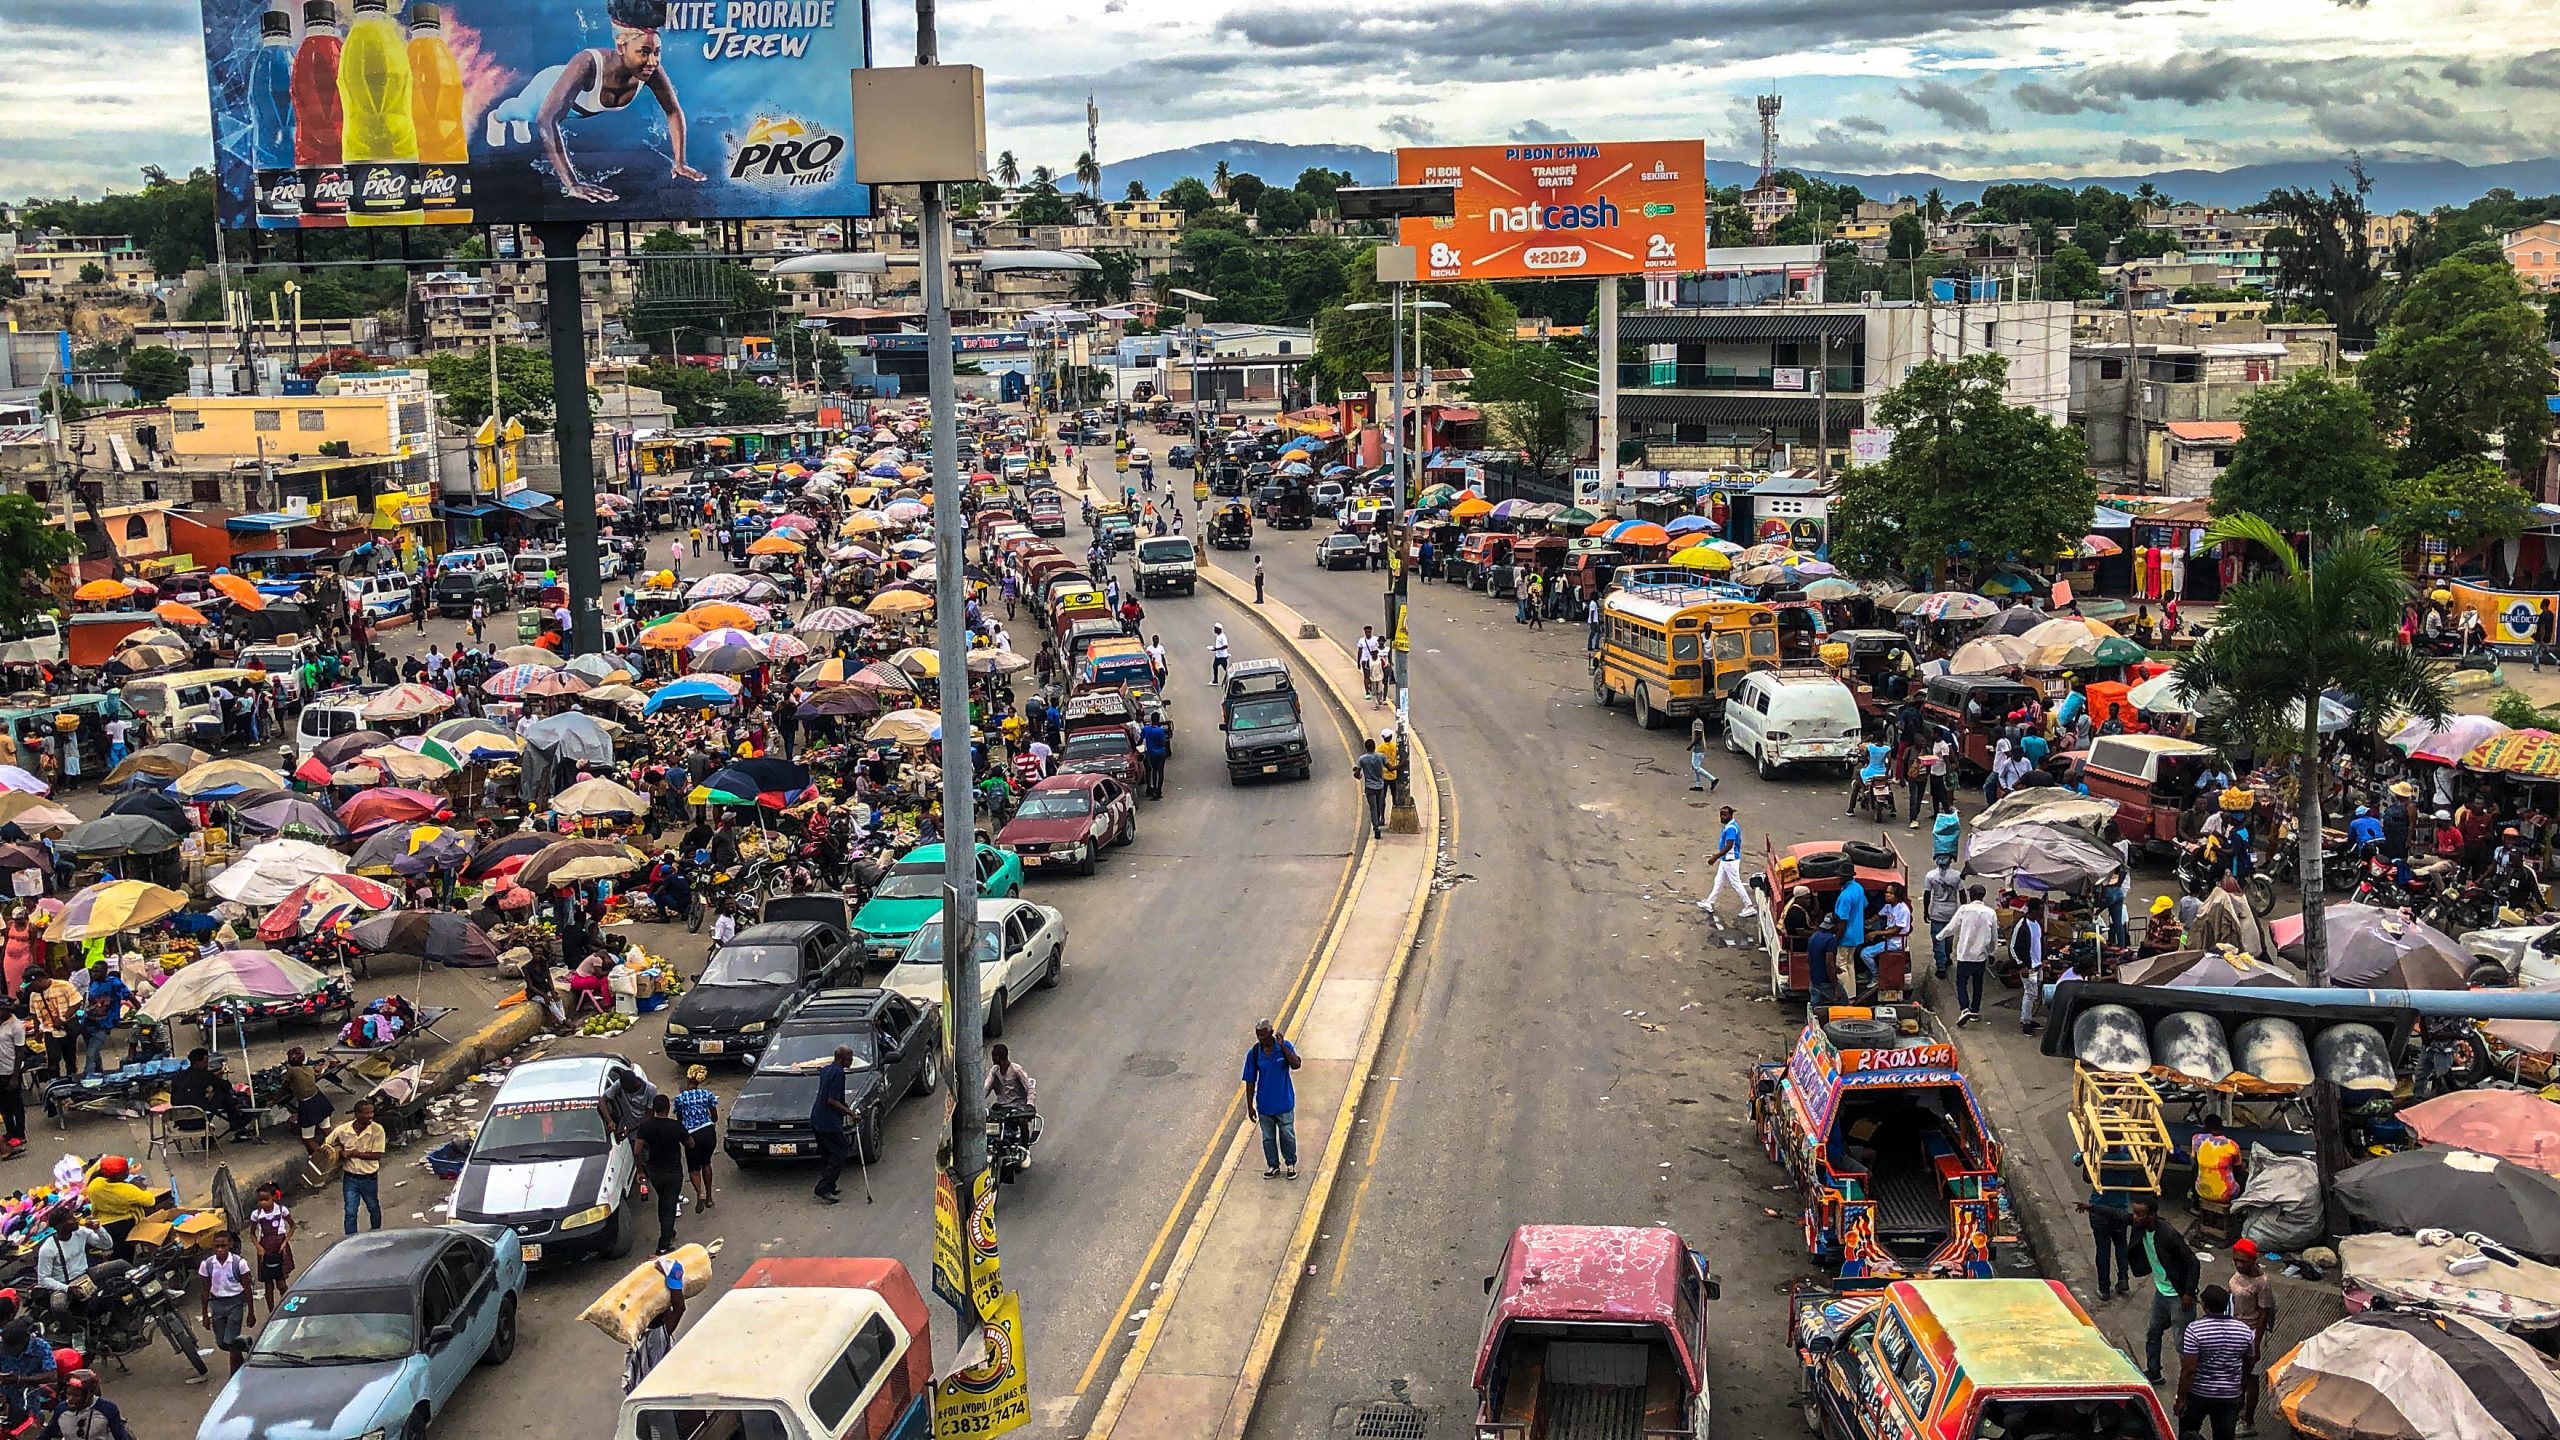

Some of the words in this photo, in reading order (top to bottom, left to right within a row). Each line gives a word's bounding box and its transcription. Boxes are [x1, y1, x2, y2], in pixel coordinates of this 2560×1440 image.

[665, 2, 716, 30] KITE
[727, 1, 835, 28] PRORADE
[703, 27, 810, 60] JEREW
[730, 135, 845, 178] PRO
[1506, 149, 1520, 161] PI
[1524, 148, 1552, 160] BON
[1557, 146, 1599, 159] CHWA
[790, 165, 834, 186] rade
[1425, 167, 1436, 178] PI
[1437, 166, 1461, 177] BON
[1538, 176, 1574, 188] GRATIS
[362, 175, 407, 197] PRO
[420, 174, 457, 195] PRO
[1489, 196, 1618, 231] natcash
[1430, 269, 1461, 278] RECHAJ
[1077, 594, 1092, 602] CAM
[1858, 1050, 1871, 1070] 2
[1919, 1046, 1950, 1065] 6:16
[1020, 1383, 1028, 1396] 19
[951, 1400, 1025, 1435] 3832-7474
